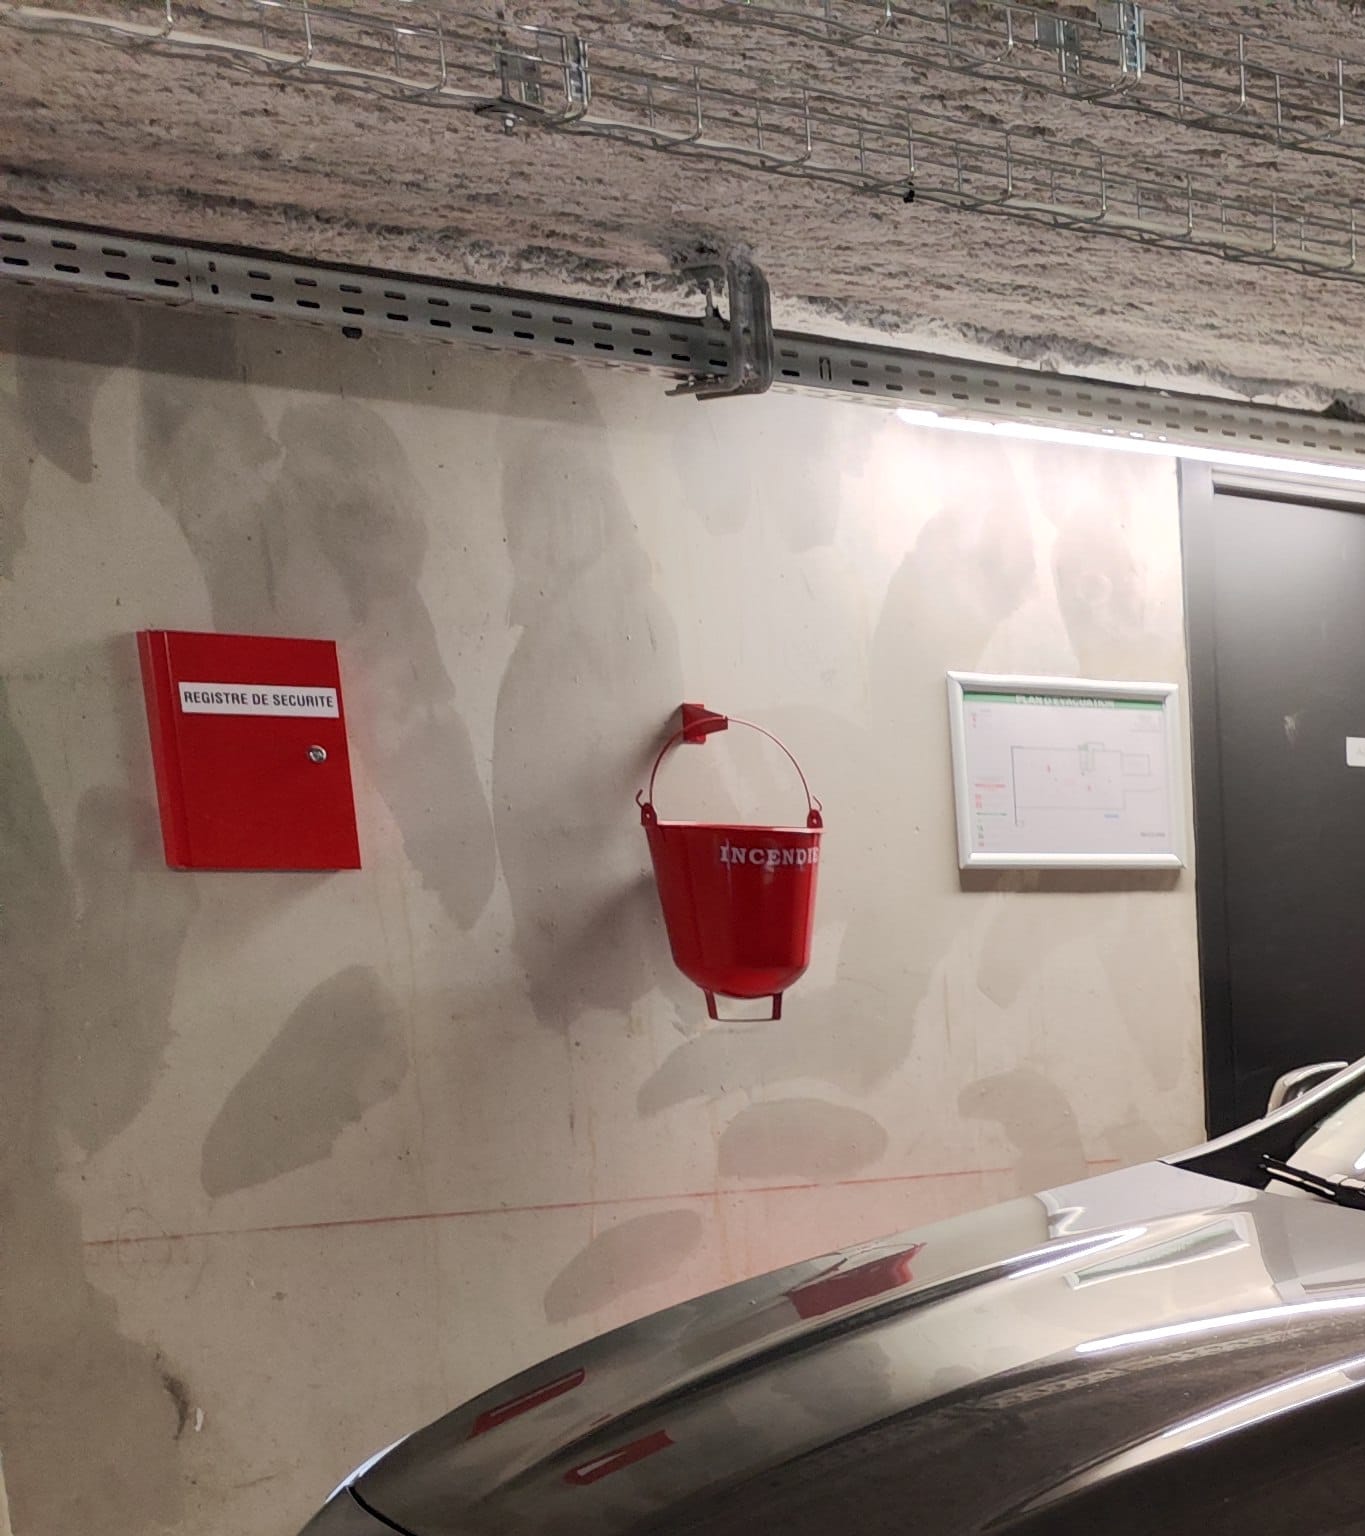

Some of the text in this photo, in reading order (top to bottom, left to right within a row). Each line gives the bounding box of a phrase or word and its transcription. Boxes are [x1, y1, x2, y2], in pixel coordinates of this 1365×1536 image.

[184, 691, 333, 708] REGISTRE DE SECURITE
